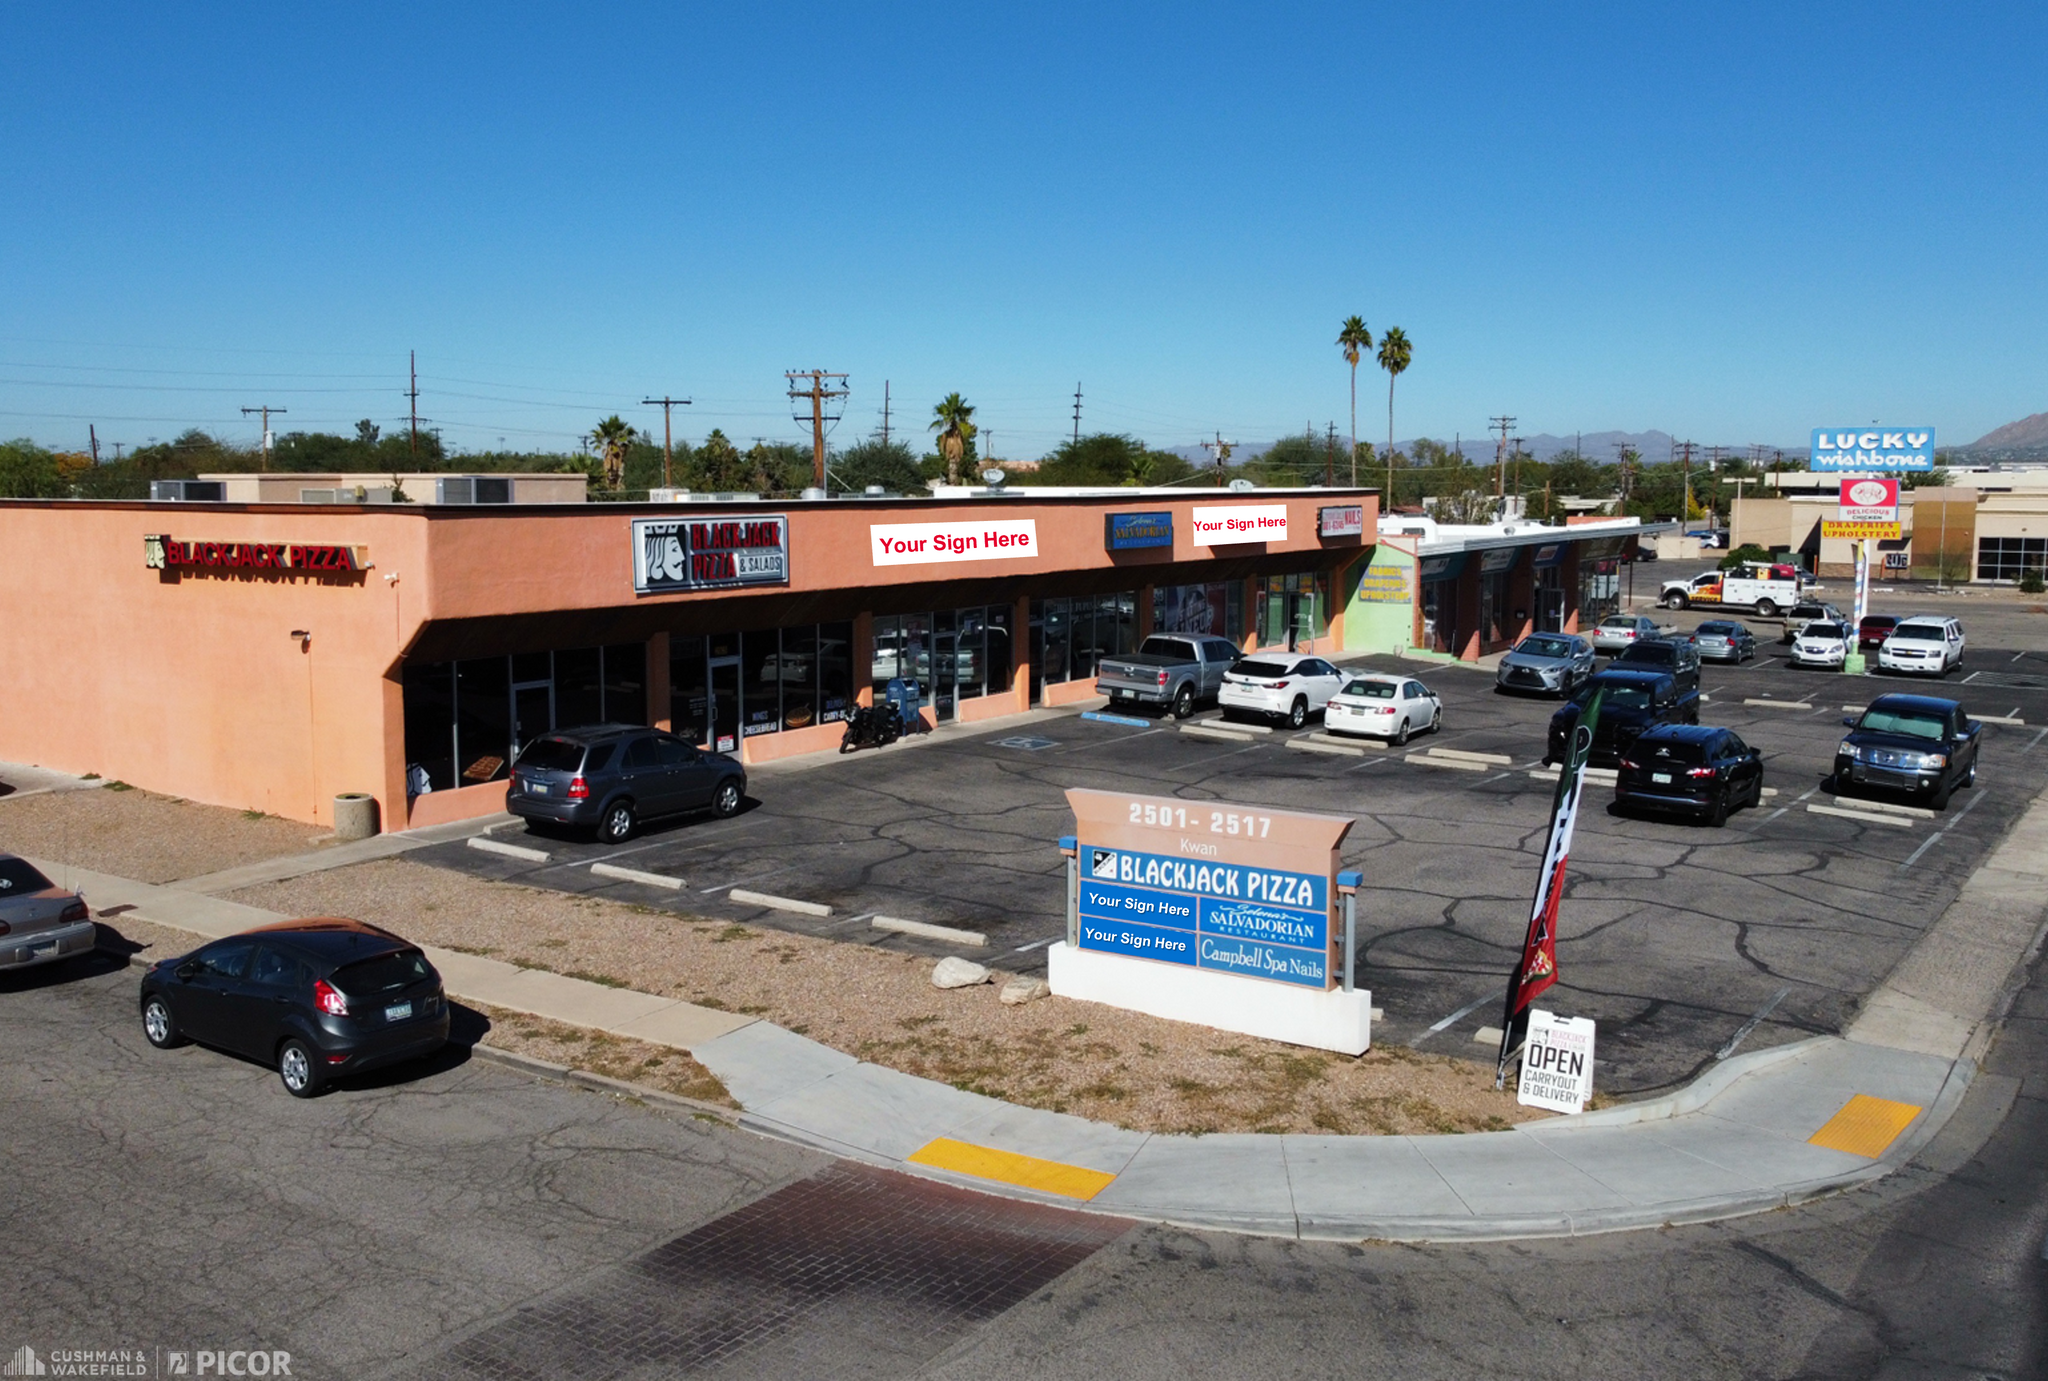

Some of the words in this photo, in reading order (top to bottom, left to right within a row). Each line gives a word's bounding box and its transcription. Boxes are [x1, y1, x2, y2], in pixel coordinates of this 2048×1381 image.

[1818, 432, 1928, 450] LUCKY
[1816, 450, 1928, 466] wishbone
[1345, 510, 1361, 525] NAILS
[1847, 508, 1890, 516] DELICIOUS
[692, 522, 780, 549] BLACKJACK
[168, 542, 282, 568] BLACKJACK
[290, 545, 351, 570] PIZZA
[693, 552, 737, 580] PIZZA
[740, 558, 746, 572] &
[749, 556, 780, 571] SALADS
[1368, 566, 1402, 576] FABRICS
[1210, 812, 1271, 838] 2517
[1180, 838, 1217, 856] Kwan
[1121, 855, 1239, 896] BLACKJACK
[1248, 872, 1313, 906] PIZZA
[1210, 911, 1314, 938] SALVADORIAN
[1219, 926, 1304, 944] RESTAURANT
[1201, 938, 1262, 968] Campbell
[1263, 949, 1287, 975] Spa
[1289, 958, 1323, 979] Nails
[1528, 1043, 1584, 1077] OPEN
[1524, 1069, 1577, 1090] CARRYOUT
[1523, 1082, 1531, 1094] &
[1532, 1085, 1579, 1104] DELIVERY
